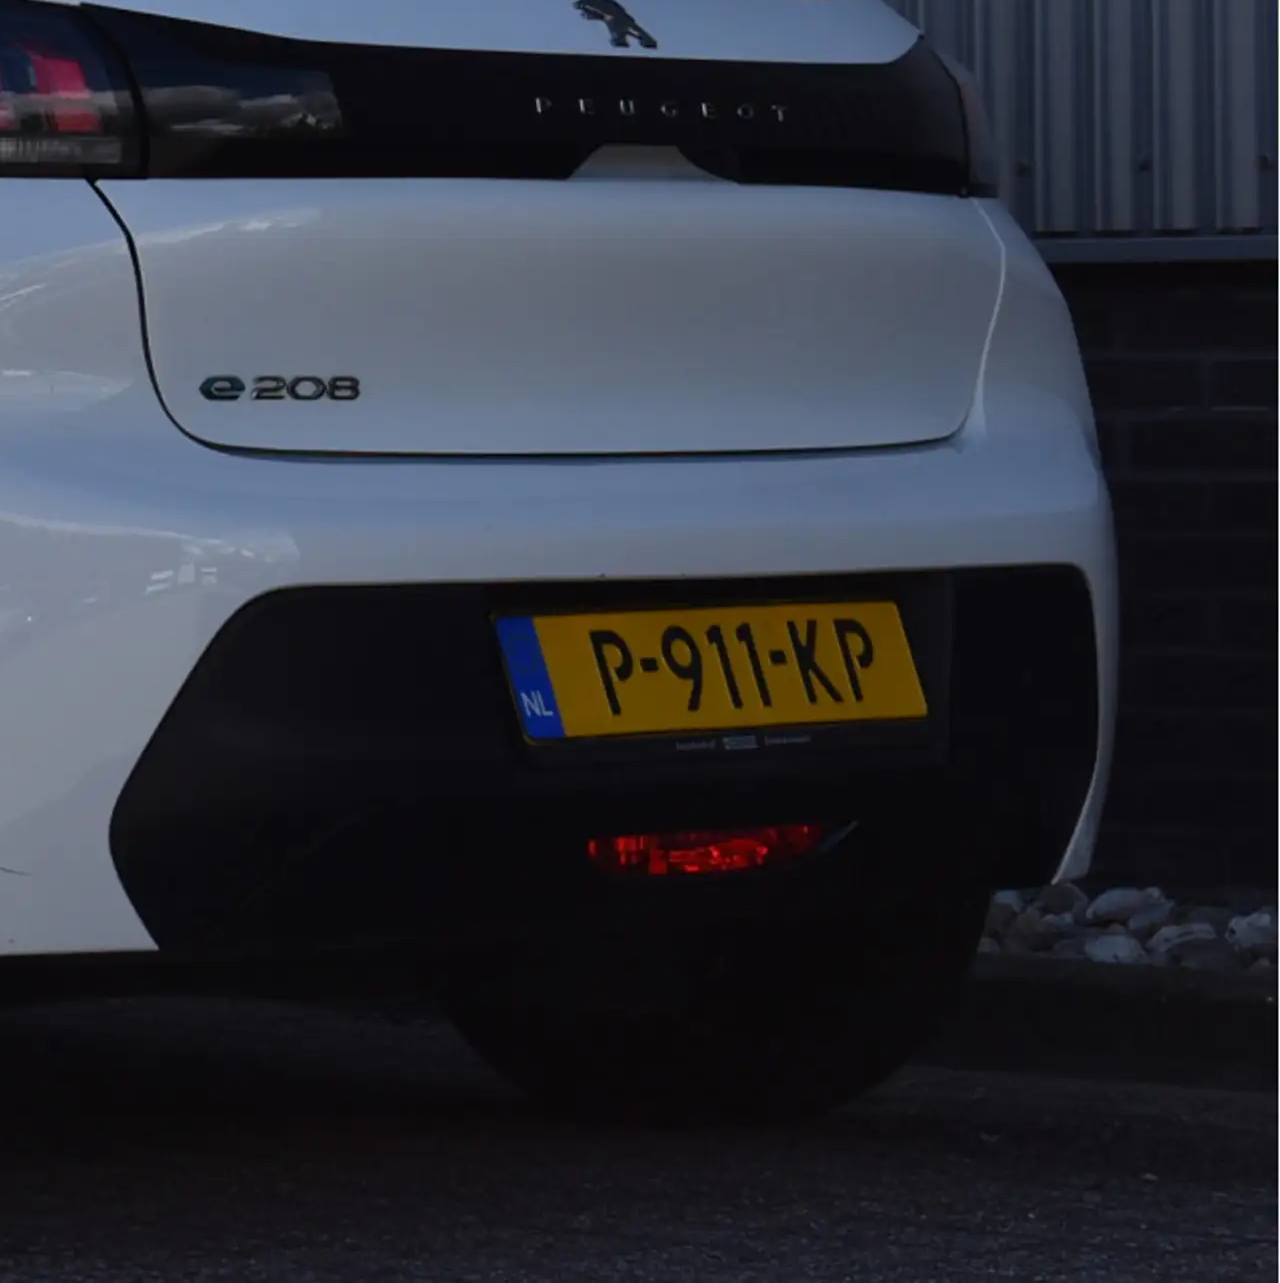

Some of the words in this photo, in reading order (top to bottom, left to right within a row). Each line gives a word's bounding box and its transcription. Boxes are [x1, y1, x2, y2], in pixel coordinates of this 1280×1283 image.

[535, 97, 787, 122] PEUGEOT
[589, 618, 874, 716] P-911-KP
[521, 690, 554, 718] NL
